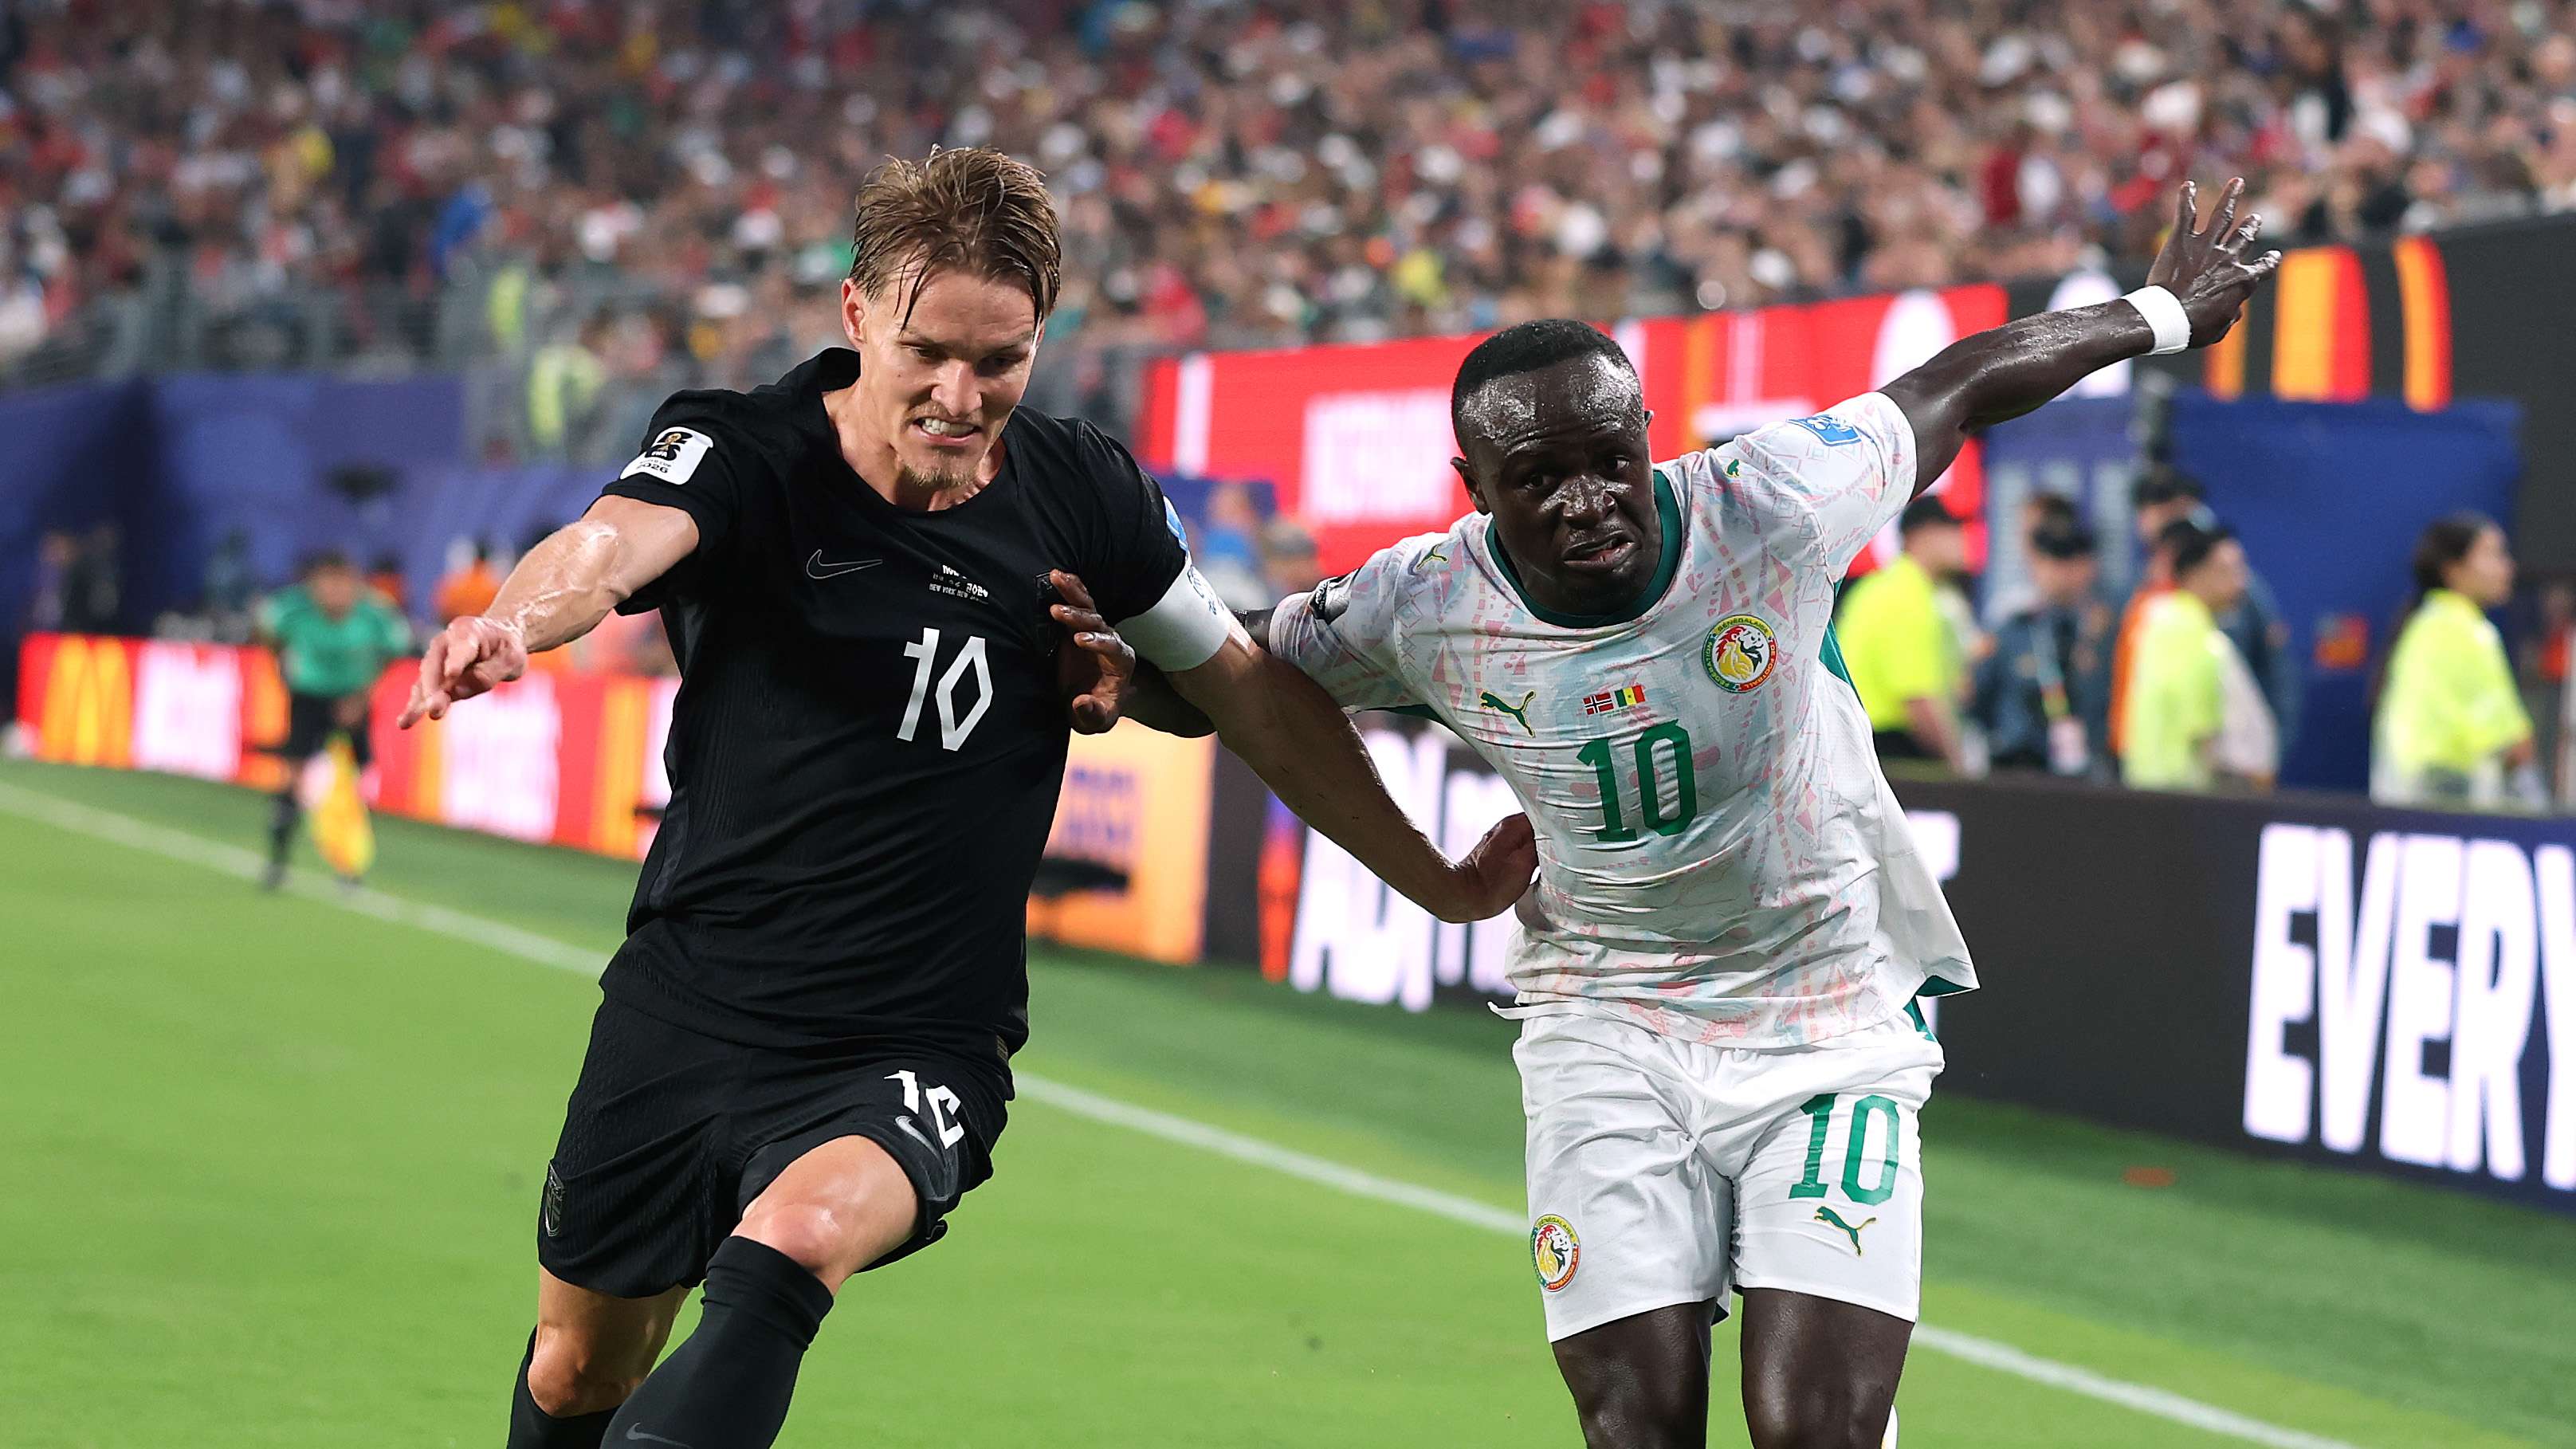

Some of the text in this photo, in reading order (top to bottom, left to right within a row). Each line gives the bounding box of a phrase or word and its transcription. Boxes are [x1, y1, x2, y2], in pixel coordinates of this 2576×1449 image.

[897, 627, 993, 751] 10
[1577, 718, 1698, 842] 10
[1788, 1093, 1899, 1206] 10
